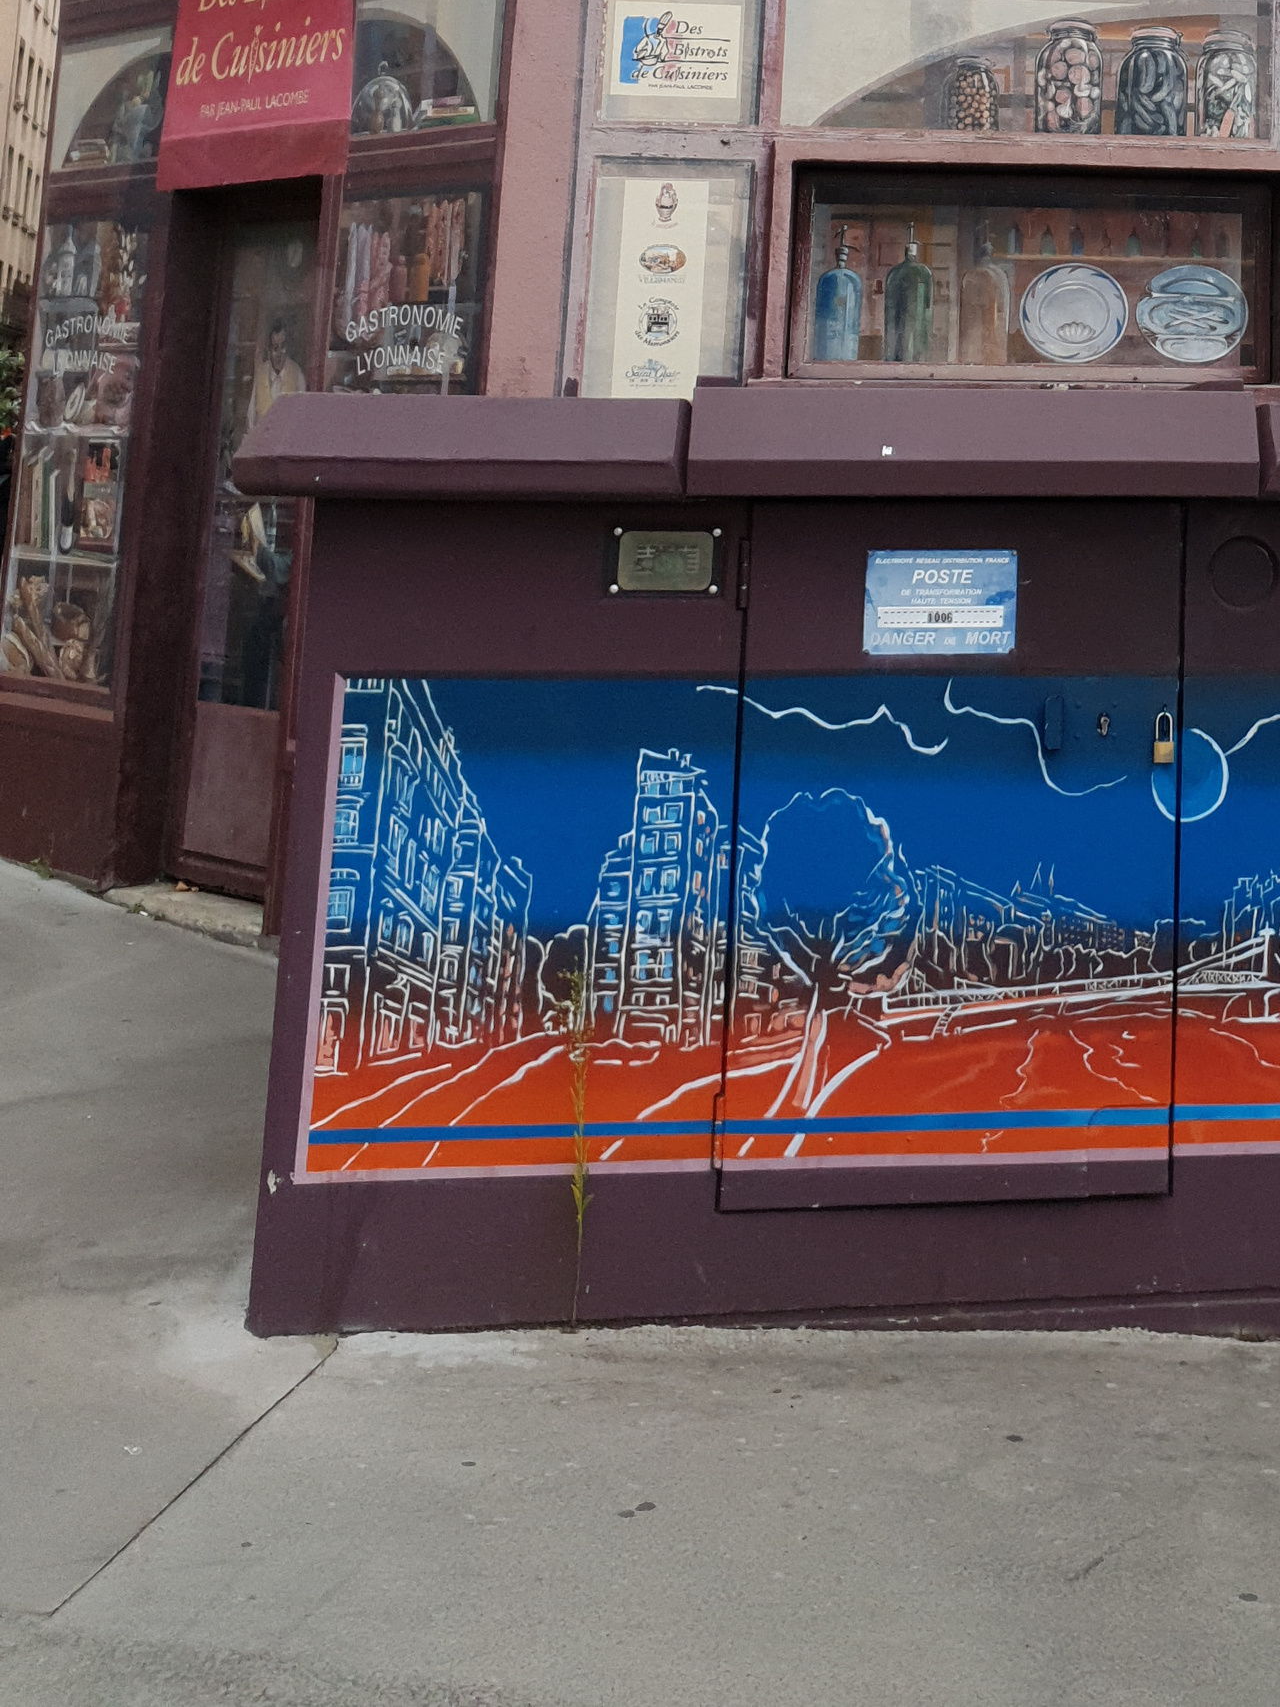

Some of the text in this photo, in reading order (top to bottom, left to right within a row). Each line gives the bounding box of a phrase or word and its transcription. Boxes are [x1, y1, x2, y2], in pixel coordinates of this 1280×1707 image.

[675, 21, 703, 34] Des
[175, 16, 345, 86] de Cuisiniers
[673, 43, 728, 59] Bistrots
[631, 65, 728, 81] de Cuisiniers
[200, 89, 310, 121] PAR JEAN-PAUL LACOMBE
[45, 315, 130, 347] GASTRONOMIE
[345, 304, 464, 342] GASTRONOMIE
[357, 345, 445, 375] LYONNAISE
[912, 569, 973, 584] POSTE
[915, 588, 983, 596] TRANSFORMATION
[927, 611, 953, 623] 1006
[870, 631, 936, 645] DANGER
[965, 631, 1012, 645] MORT
